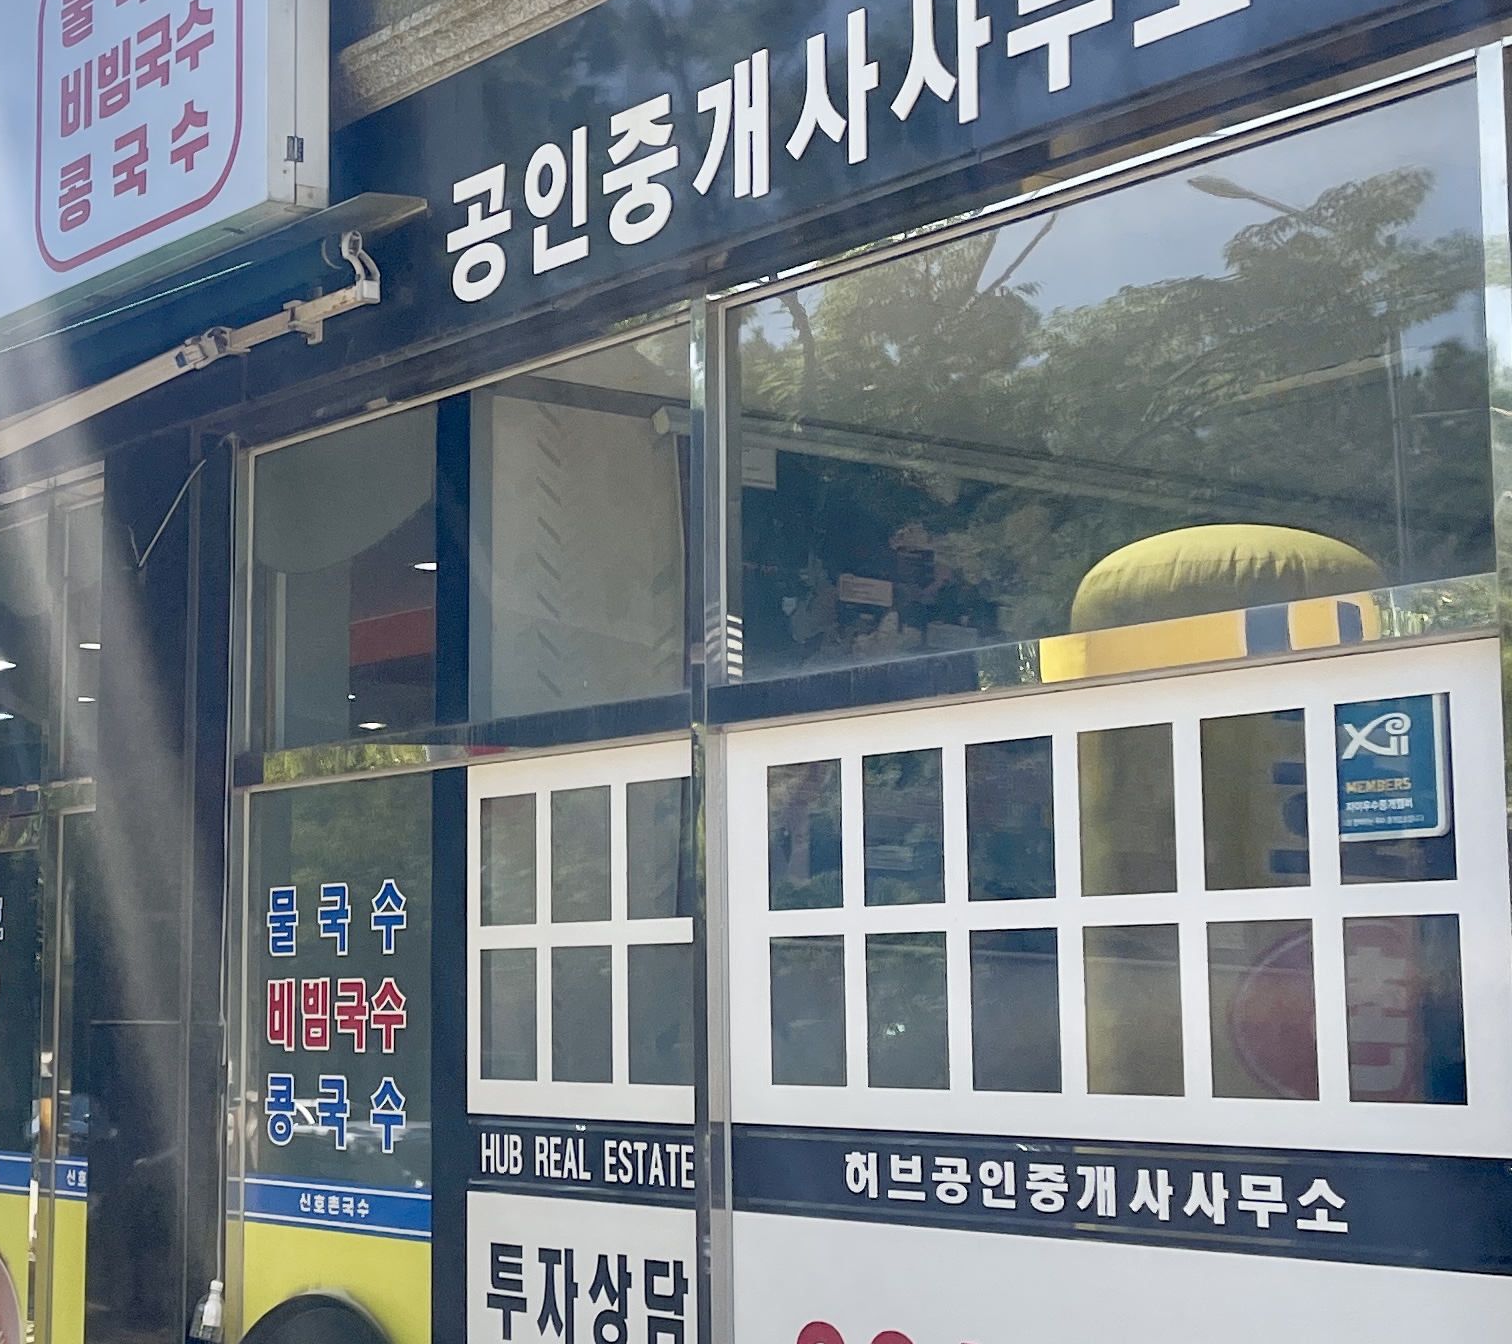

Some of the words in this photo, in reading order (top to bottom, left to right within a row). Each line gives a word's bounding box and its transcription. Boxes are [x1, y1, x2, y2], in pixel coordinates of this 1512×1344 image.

[58, 99, 210, 233] 콩국수
[1345, 777, 1412, 794] MEMBERS
[266, 878, 407, 957] 물국수
[266, 977, 407, 1053] 비빔국수
[265, 1073, 406, 1154] 콩국수
[481, 1132, 523, 1175] HUB
[535, 1135, 592, 1181] REAL
[604, 1140, 695, 1189] ESTATE
[844, 1151, 1349, 1234] 허브공인중개사사무소
[299, 1193, 370, 1218] 신호촌국수
